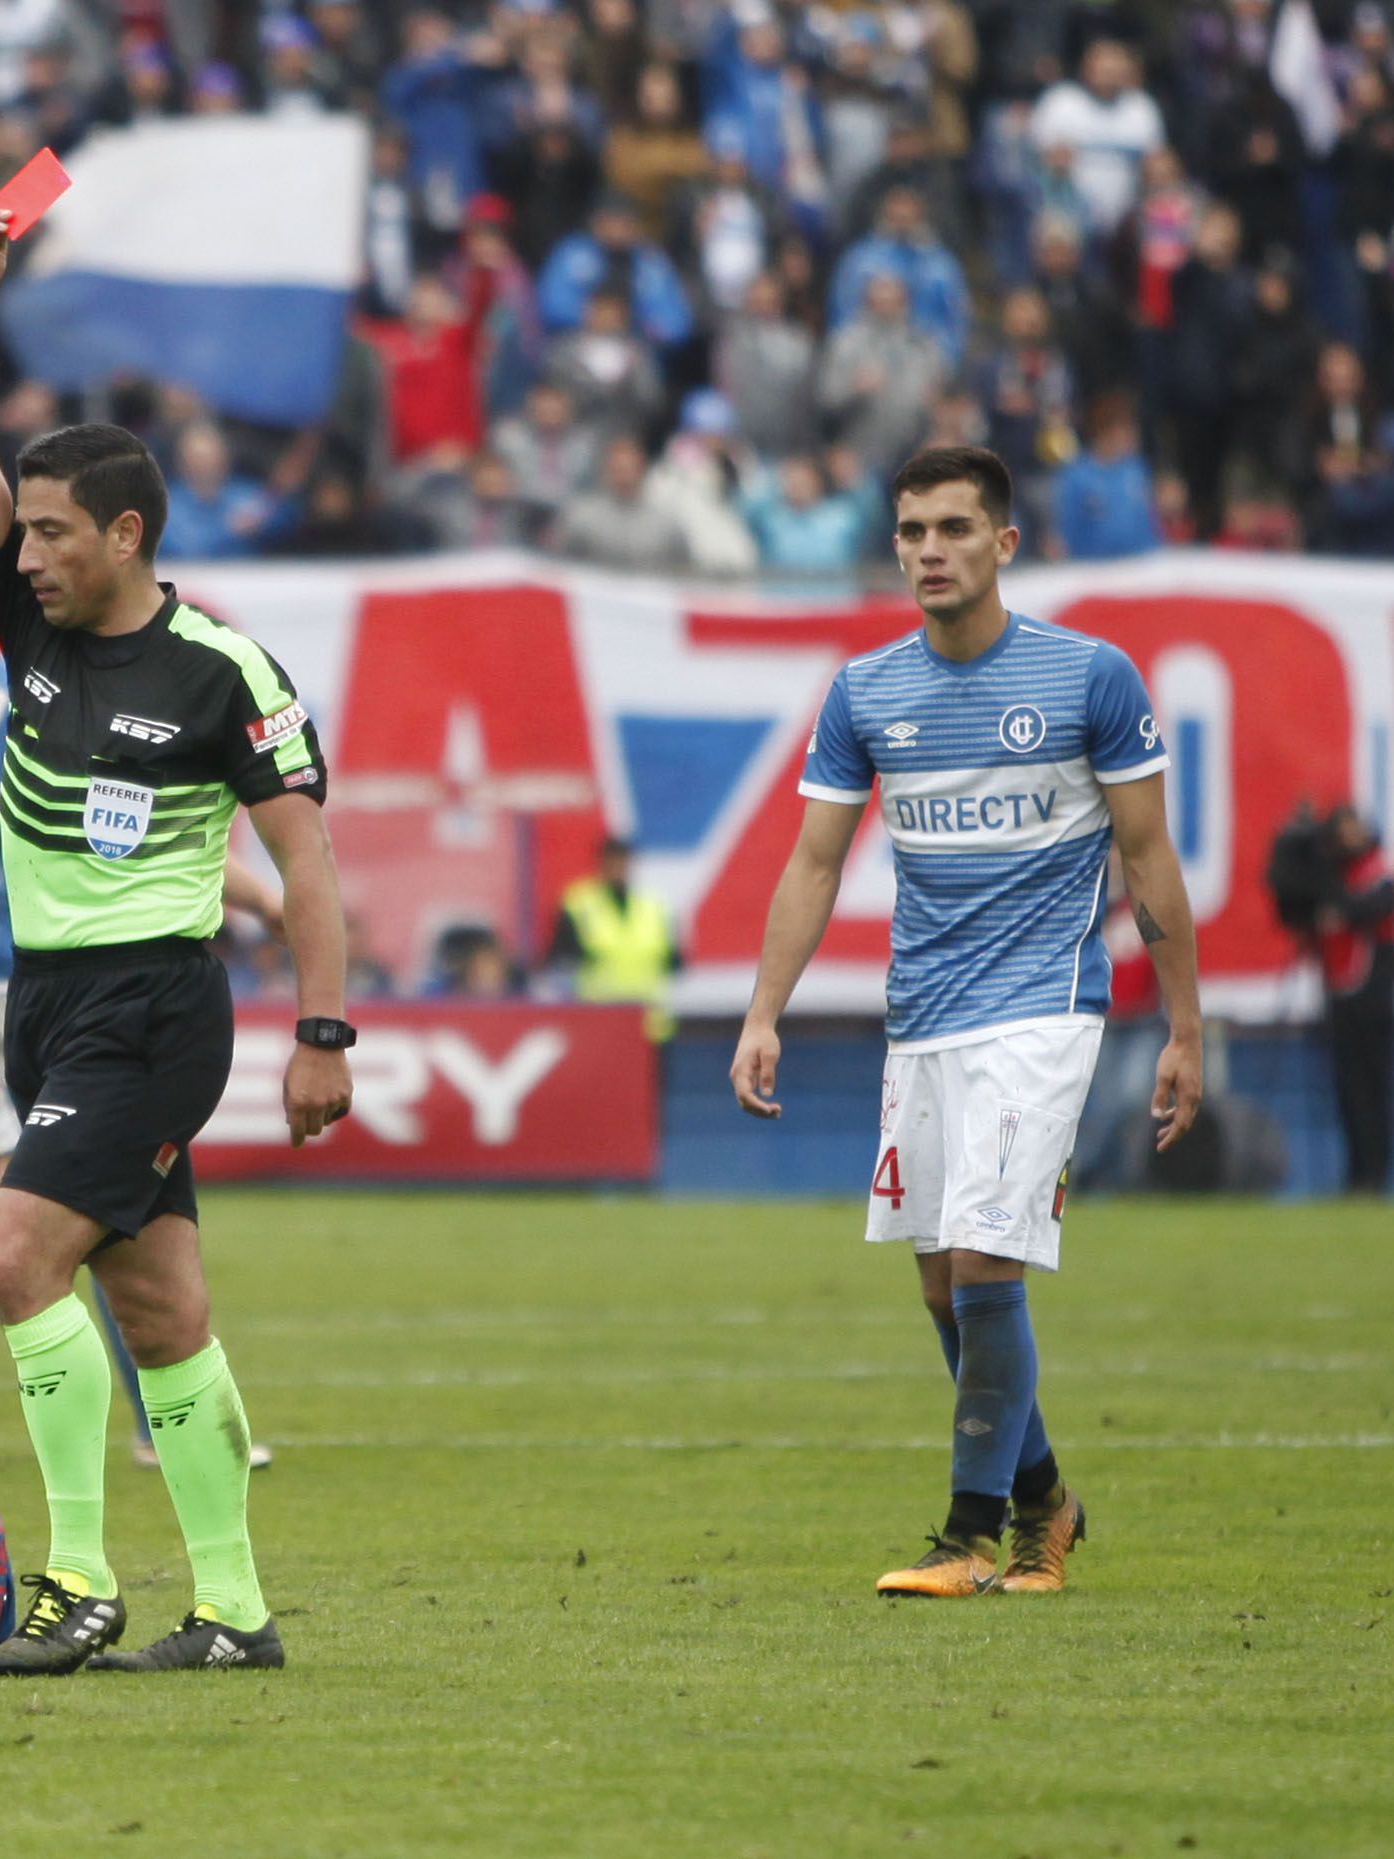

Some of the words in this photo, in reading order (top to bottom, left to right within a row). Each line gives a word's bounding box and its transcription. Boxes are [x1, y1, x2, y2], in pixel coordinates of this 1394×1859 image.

[109, 716, 176, 744] KS7
[887, 739, 917, 749] umbro
[92, 783, 149, 804] REFEREE
[91, 808, 139, 833] FIFA
[893, 788, 1057, 833] DIRECTV
[98, 844, 122, 856] 2018
[872, 1145, 906, 1211] 4
[975, 1220, 1006, 1233] umbro
